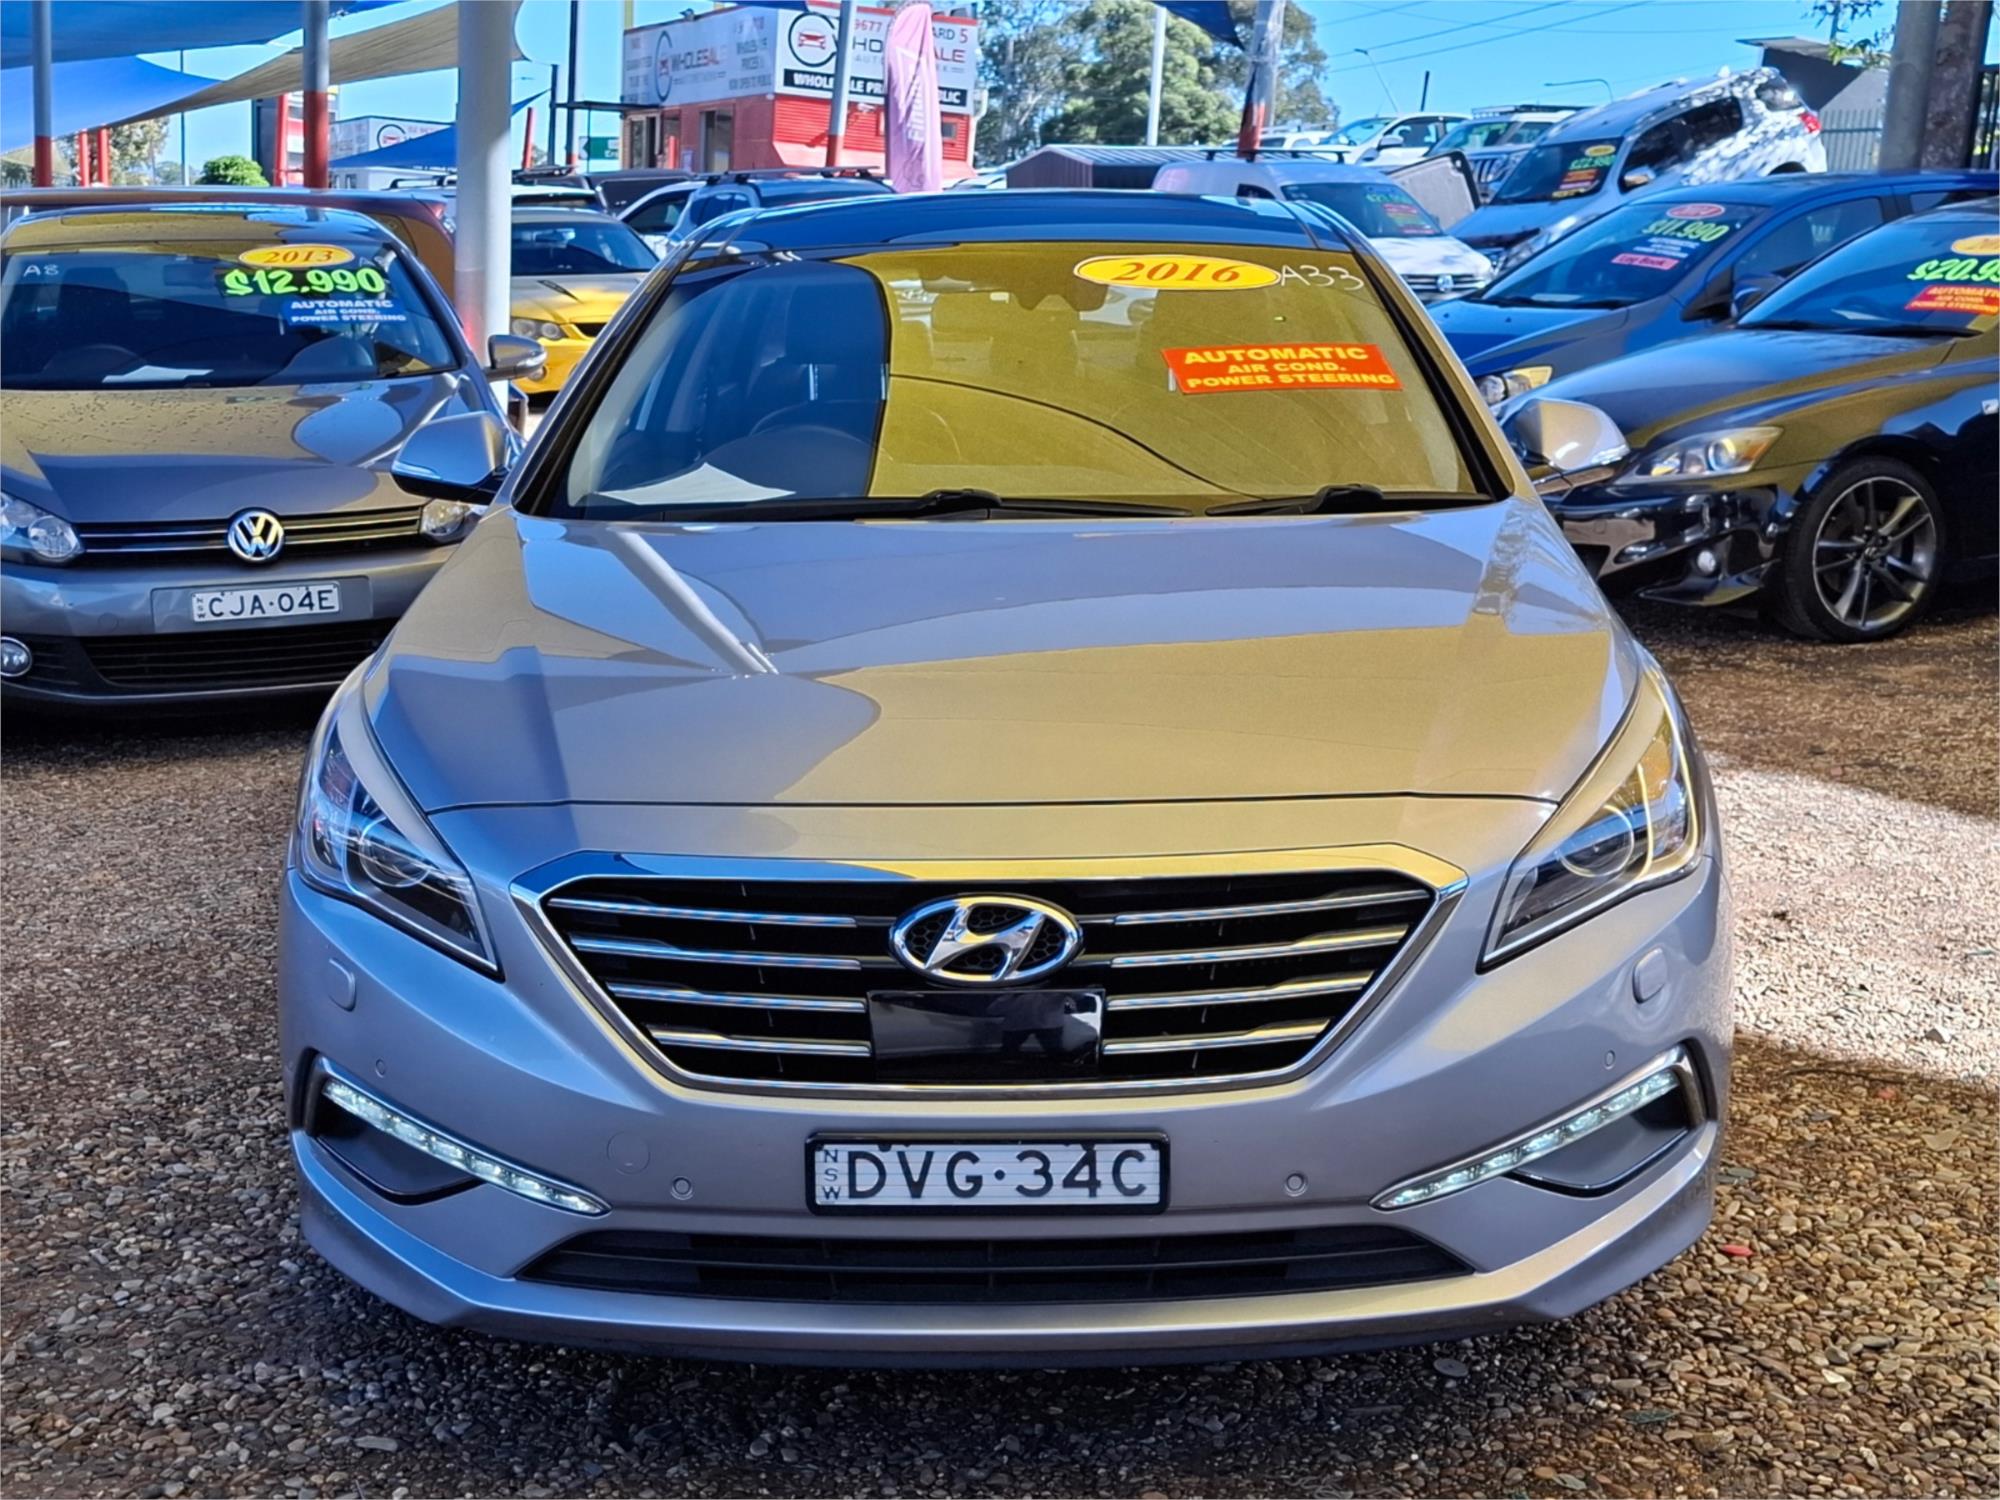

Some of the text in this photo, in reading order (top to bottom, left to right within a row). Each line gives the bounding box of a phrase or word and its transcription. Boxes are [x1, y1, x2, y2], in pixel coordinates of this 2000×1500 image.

[959, 28, 968, 44] 5
[263, 249, 335, 264] 2013
[23, 264, 59, 277] A8
[1110, 260, 1241, 283] 2016
[1280, 263, 1365, 291] A33
[223, 267, 386, 296] $12.990
[290, 299, 394, 309] AUTOMATIC
[291, 314, 406, 322] POWER STEERING
[314, 308, 337, 316] AIR
[1184, 346, 1369, 364] AUTOMATIC
[1227, 361, 1347, 374] AIR COND.
[1186, 373, 1396, 388] POWER STEERING
